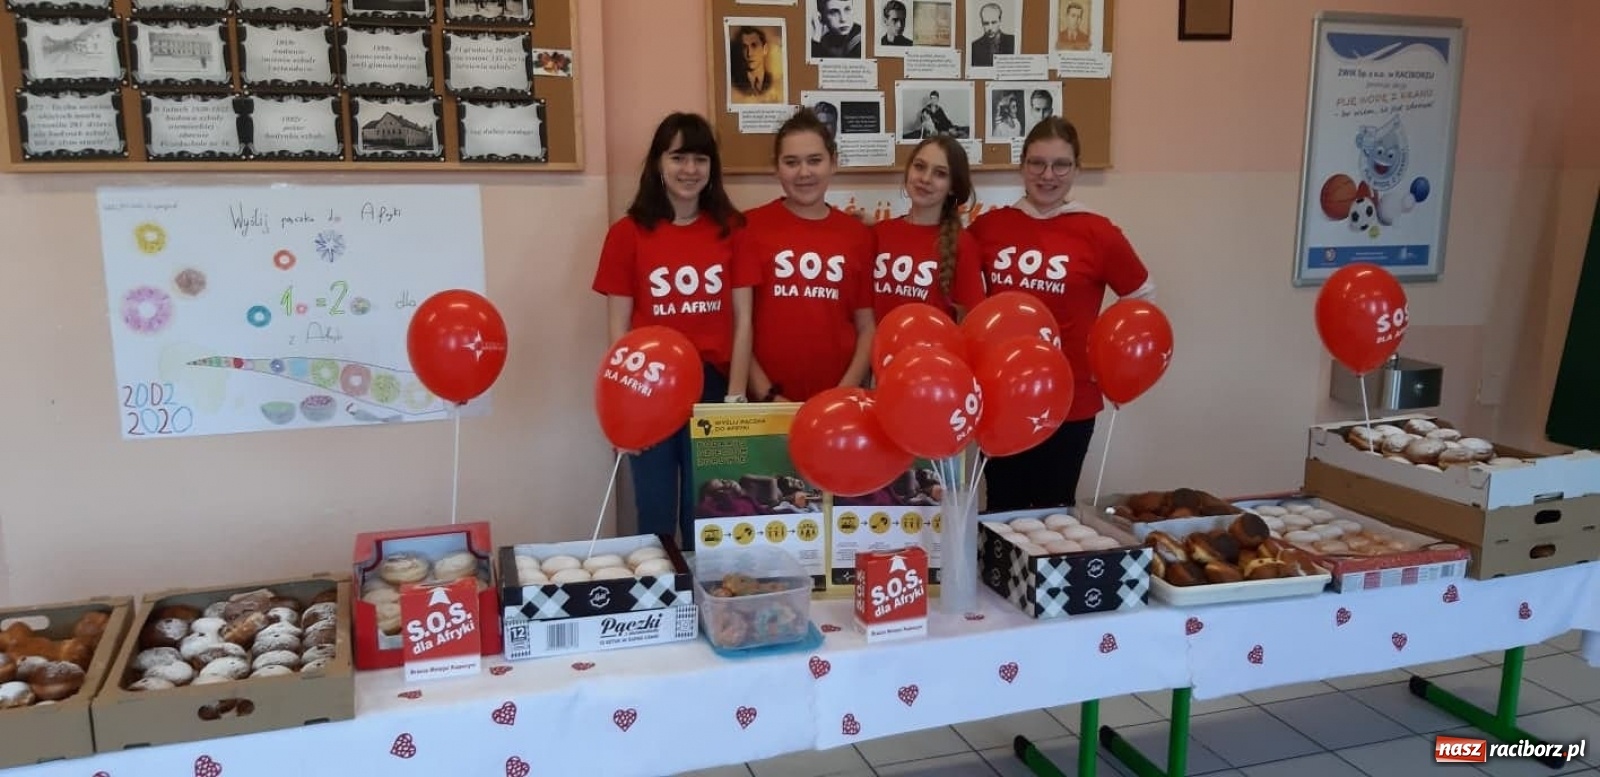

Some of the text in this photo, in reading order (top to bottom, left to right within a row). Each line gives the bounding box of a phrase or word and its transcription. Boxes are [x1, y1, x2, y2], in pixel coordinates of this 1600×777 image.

[774, 250, 845, 282] SOS
[873, 253, 938, 287] SOS
[994, 246, 1069, 280] SOS
[649, 264, 723, 297] SOS
[774, 285, 798, 297] DLA
[991, 272, 1065, 294] DLA AFRYKI
[653, 299, 722, 316] DLA AFRYKI
[610, 347, 666, 382] SOS
[122, 382, 178, 409] 2002
[127, 405, 193, 435] 2020
[871, 568, 923, 606] S.O.S.
[874, 585, 925, 618] dla Afryki
[407, 602, 473, 642] S.O.S.
[413, 619, 475, 655] dla Afryki
[512, 627, 525, 639] 12
[601, 612, 663, 636] Pączki
